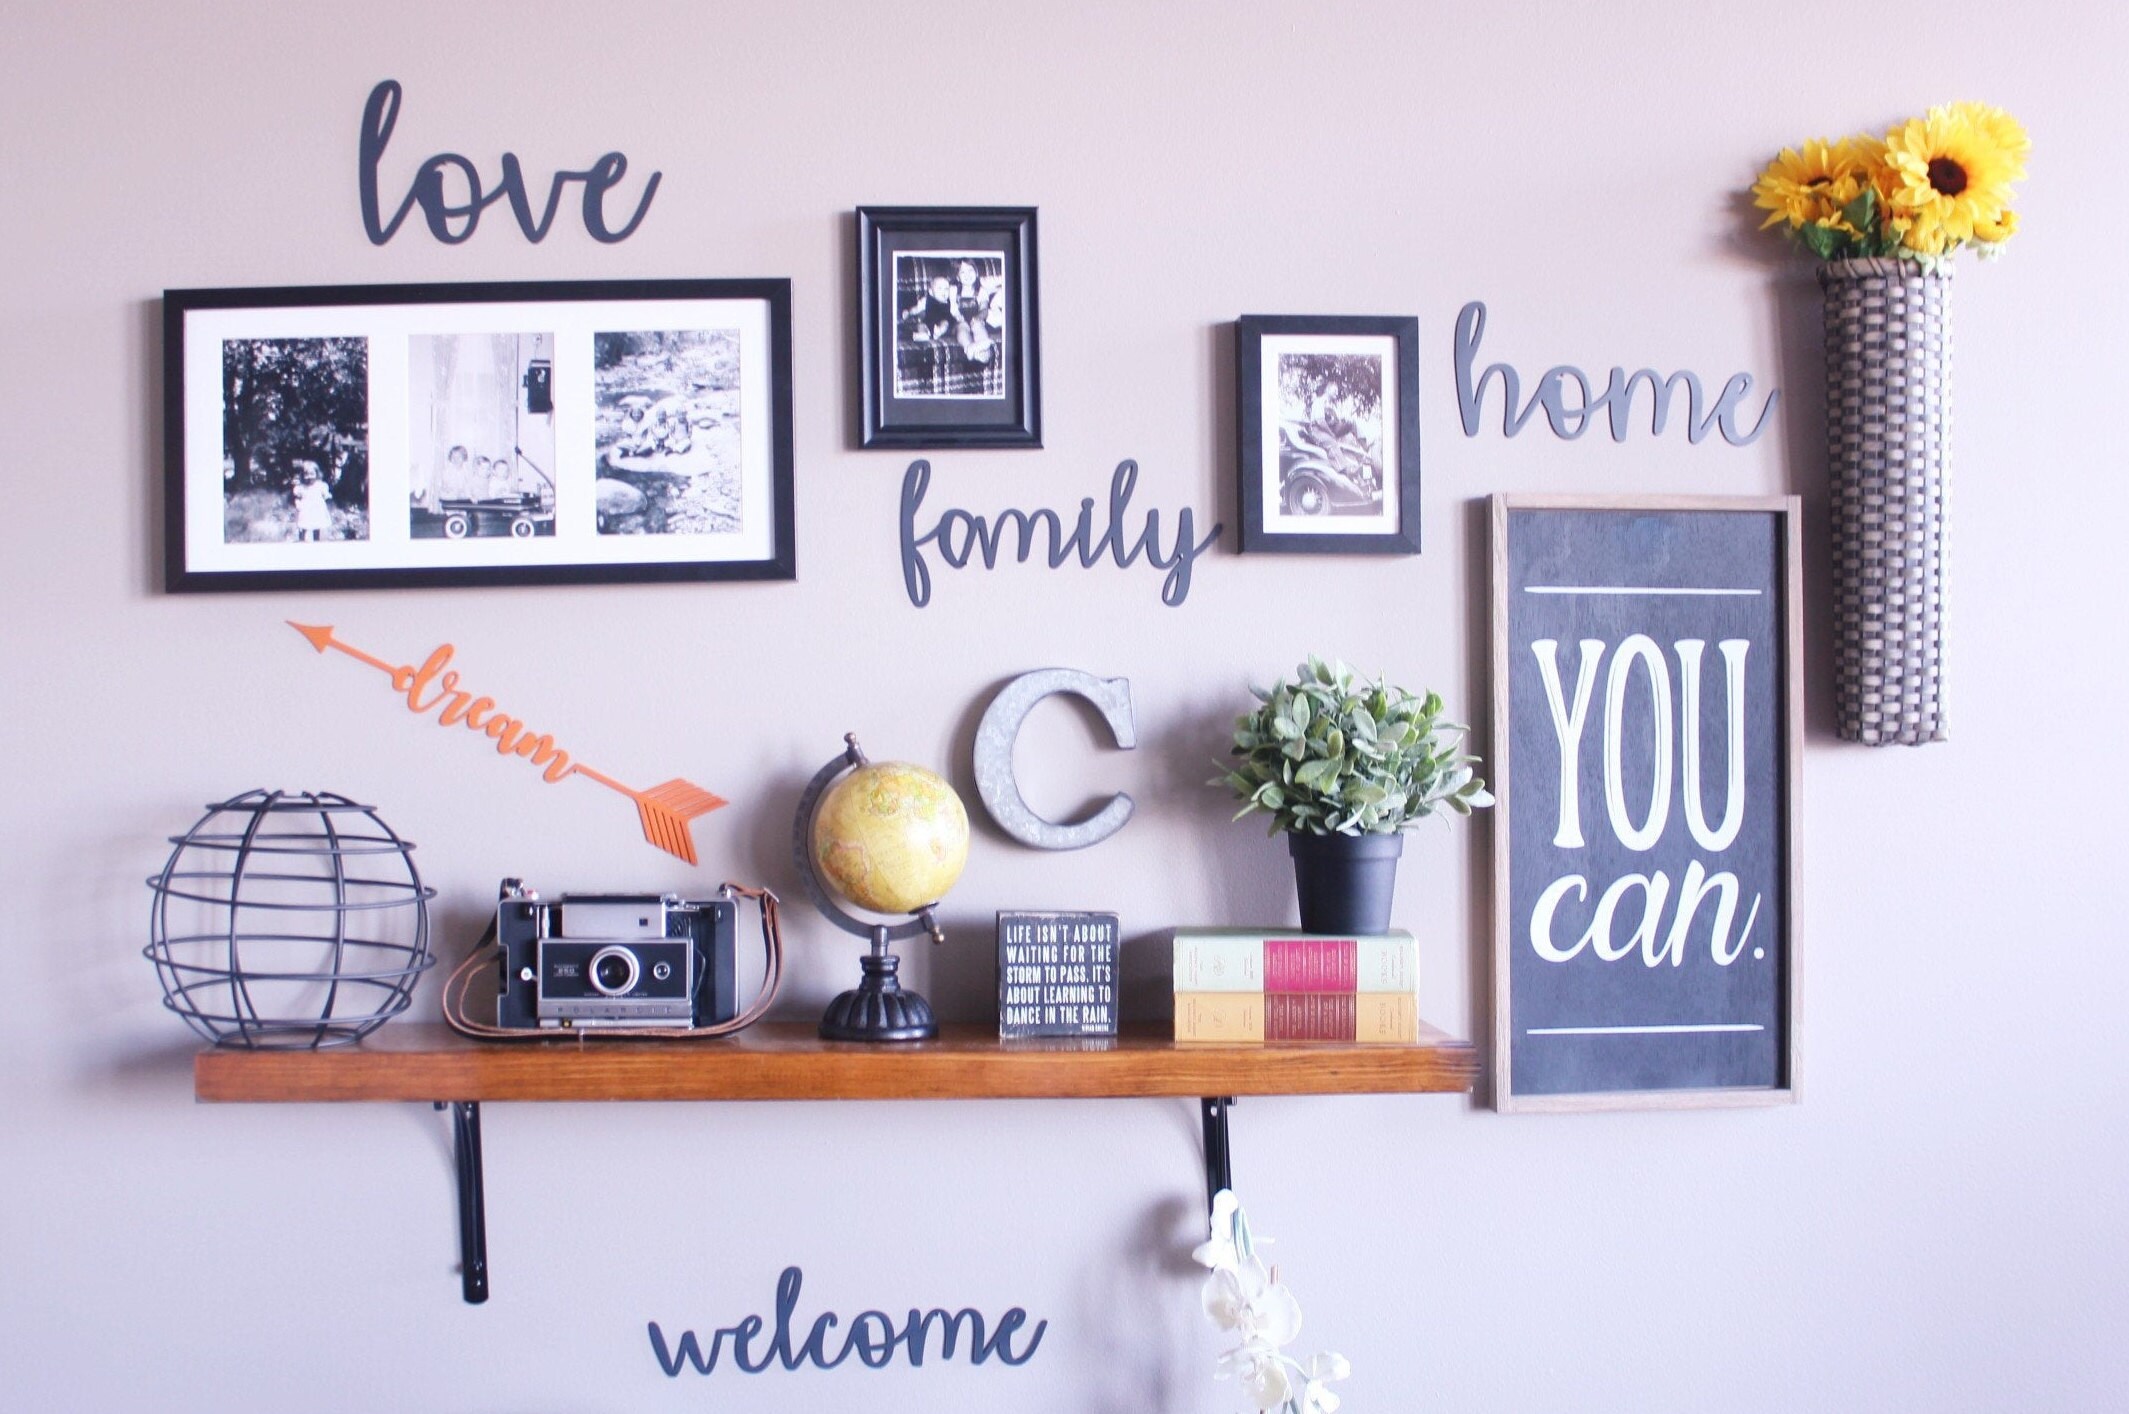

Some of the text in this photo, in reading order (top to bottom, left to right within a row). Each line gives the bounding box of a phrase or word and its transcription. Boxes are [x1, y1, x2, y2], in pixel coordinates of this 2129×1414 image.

[359, 79, 662, 245] love
[1454, 301, 1781, 447] home
[900, 459, 1223, 608] family
[391, 643, 577, 783] dream
[971, 667, 1136, 851] C
[1531, 633, 1751, 852] YOU
[1006, 924, 1112, 943] LIFE ISN'T ABOUT
[1006, 944, 1111, 964] WAITING FOR THE
[1530, 859, 1765, 968] can.
[1006, 966, 1041, 984] STORM
[1044, 965, 1057, 984] TO
[1092, 965, 1111, 983] IT'S
[1006, 985, 1111, 1004] ABOUT LEARNING TO
[1006, 1005, 1112, 1025] DANCE IN THE RAIN.
[648, 1266, 1048, 1377] welcome
